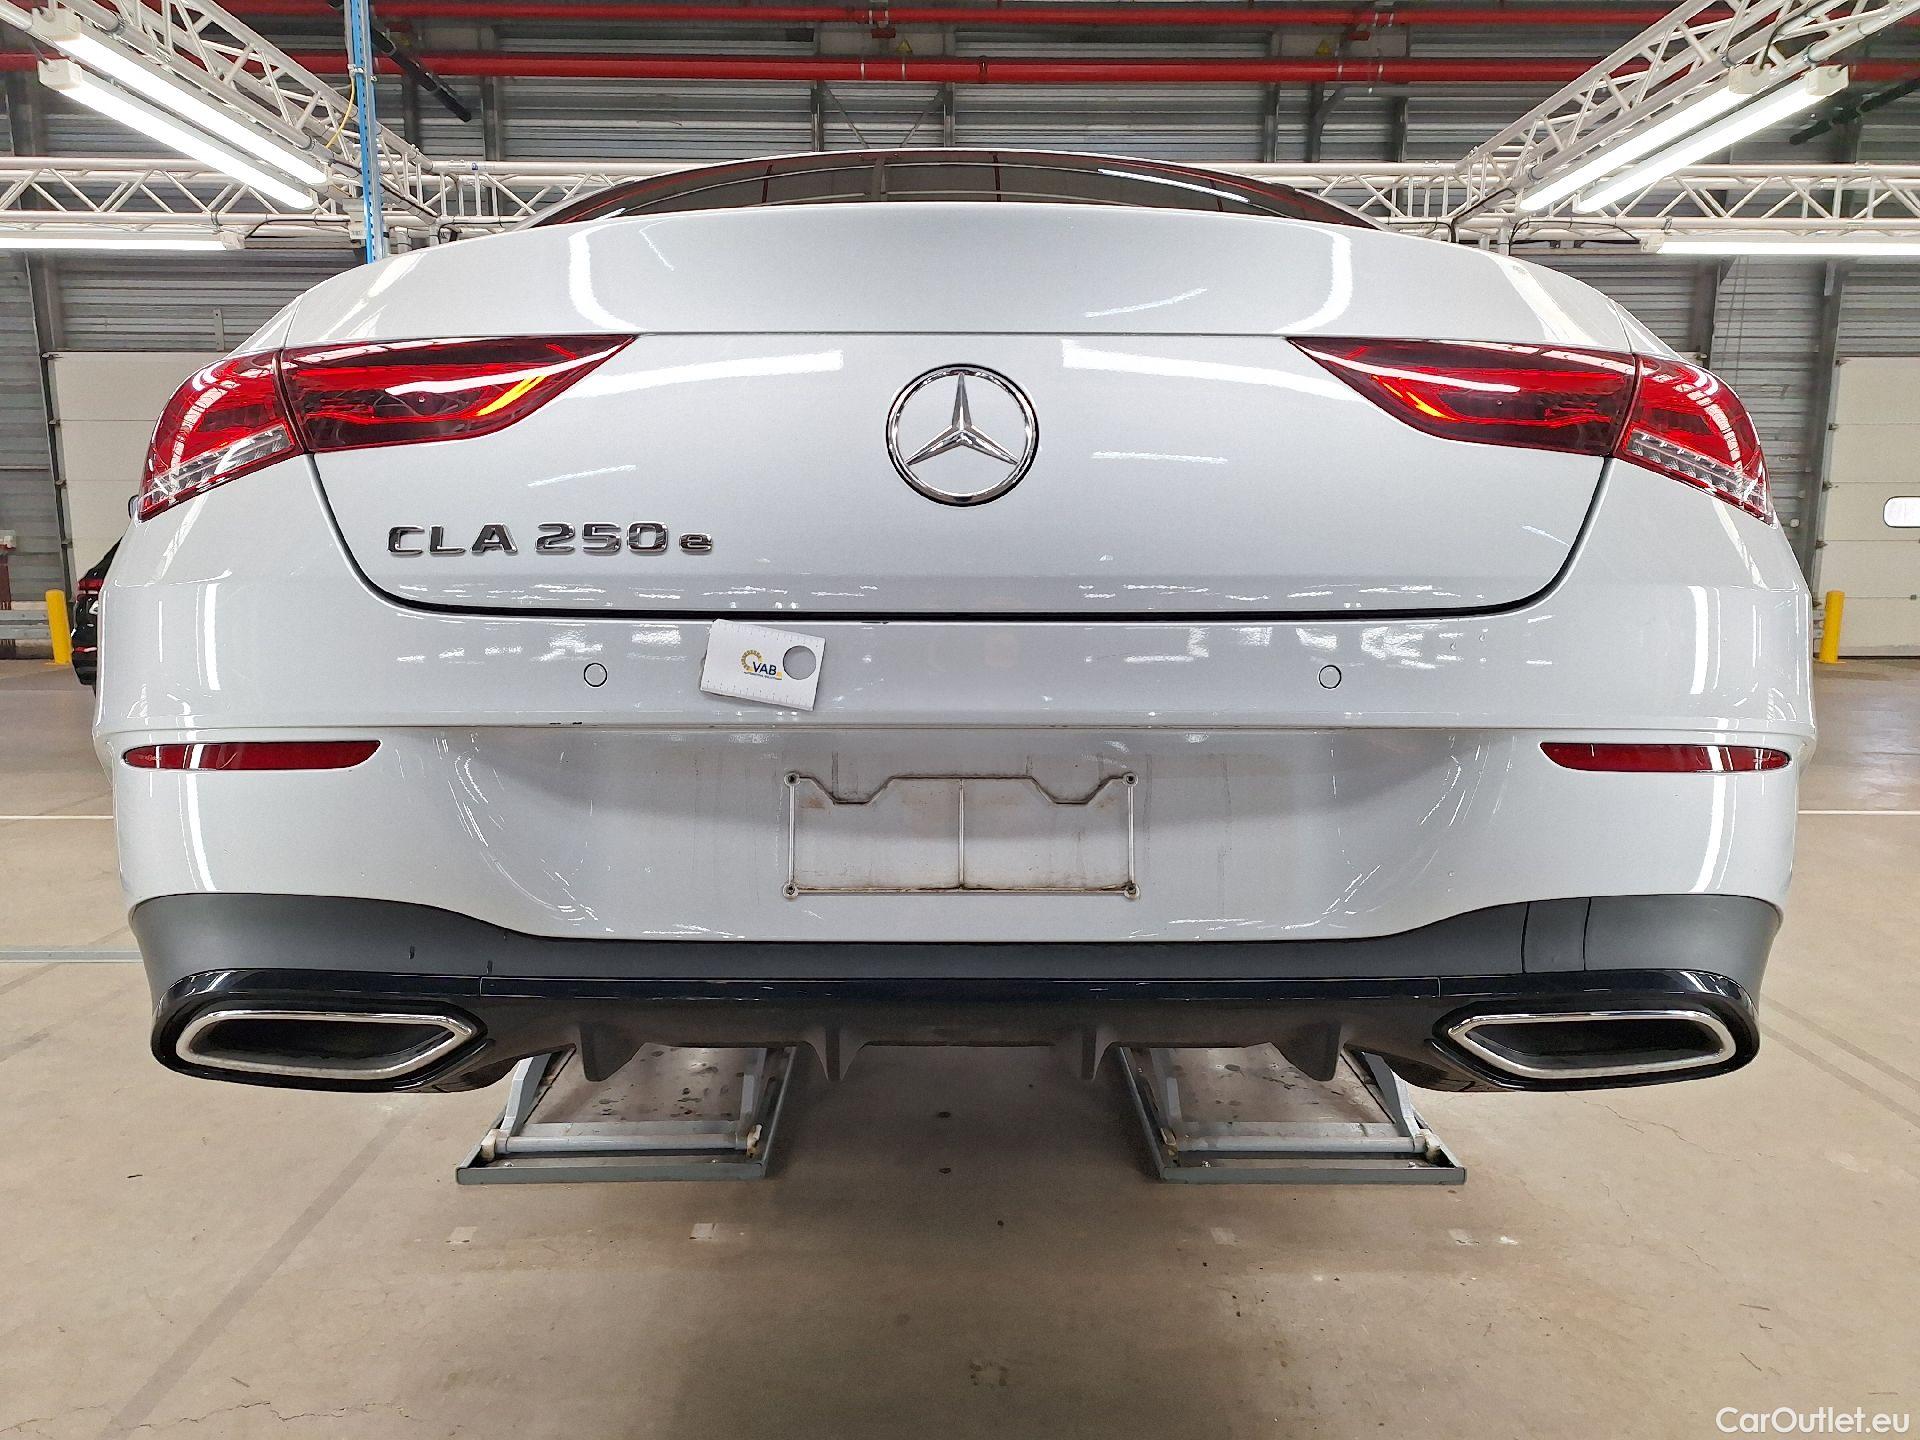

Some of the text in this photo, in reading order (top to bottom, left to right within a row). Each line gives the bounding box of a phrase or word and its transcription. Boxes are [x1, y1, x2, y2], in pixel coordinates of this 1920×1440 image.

[387, 520, 713, 555] CLA 250 e
[753, 661, 777, 675] VAB
